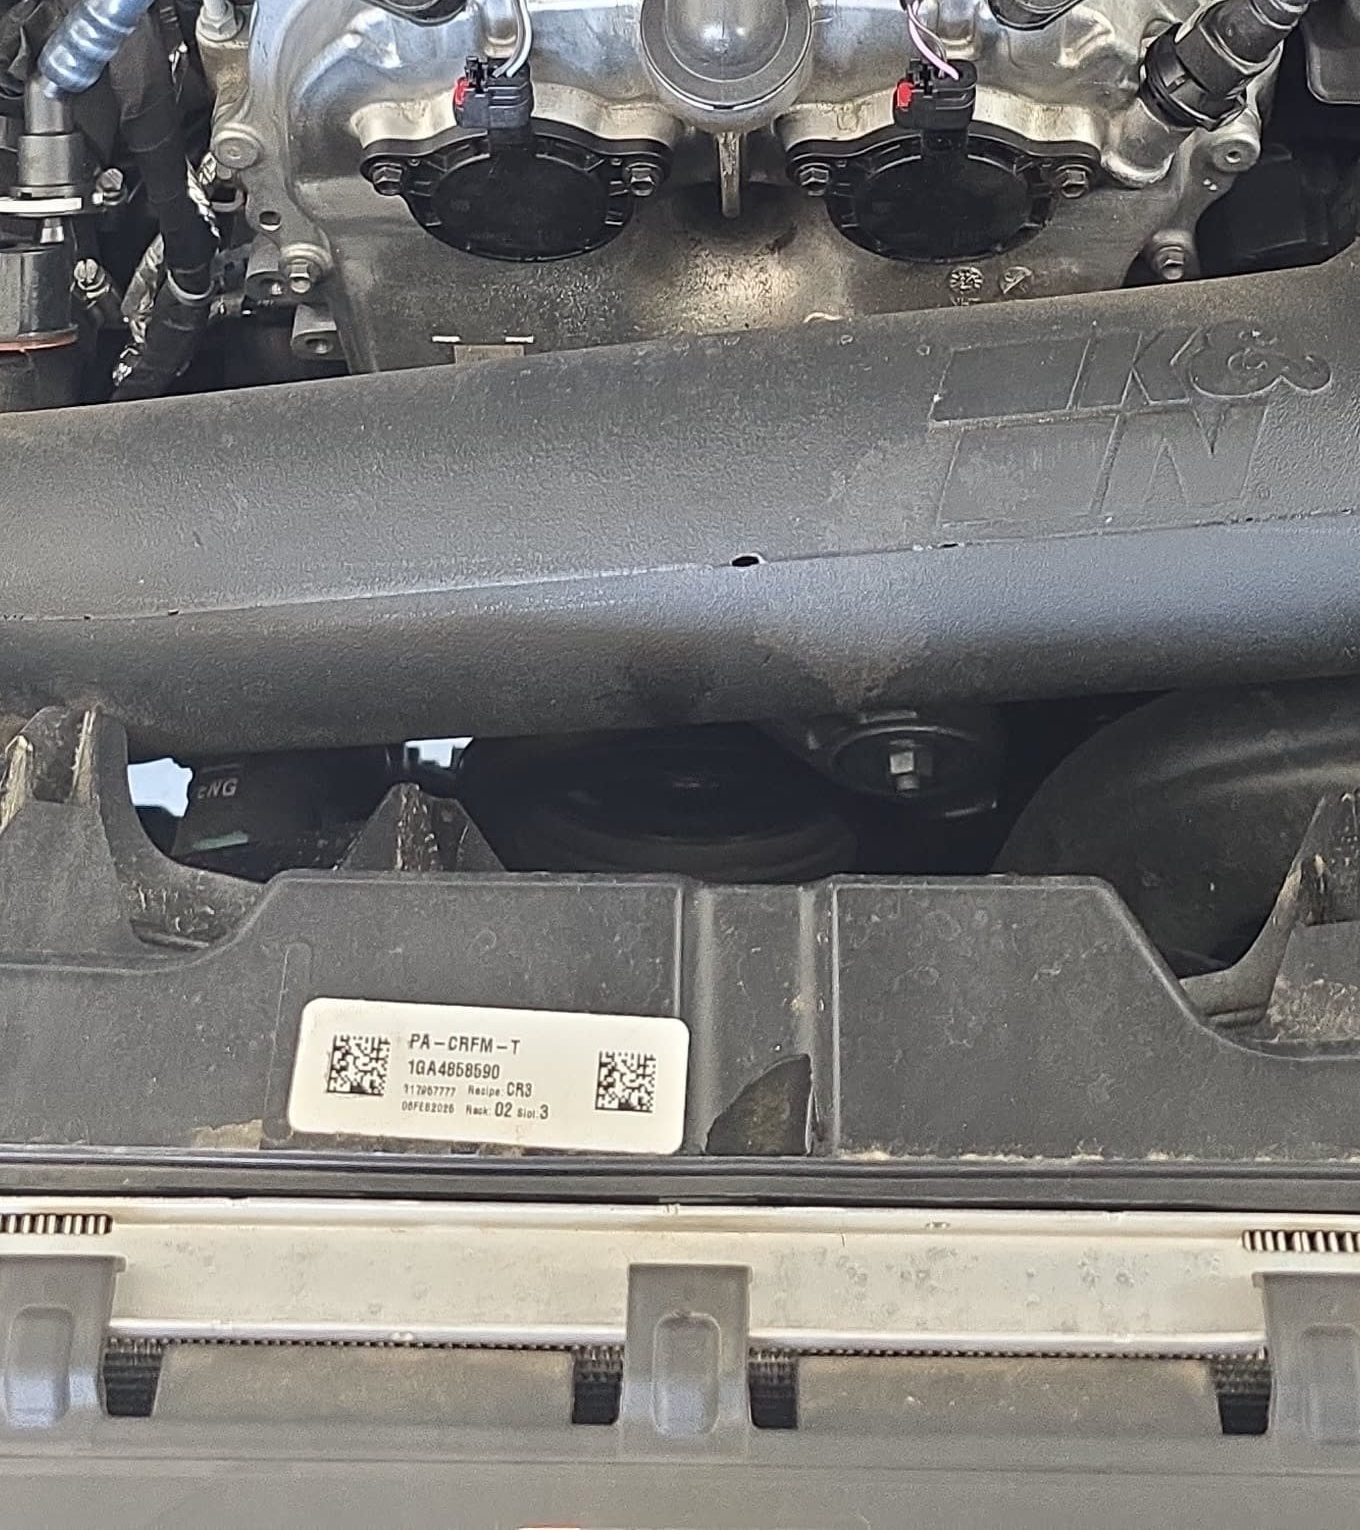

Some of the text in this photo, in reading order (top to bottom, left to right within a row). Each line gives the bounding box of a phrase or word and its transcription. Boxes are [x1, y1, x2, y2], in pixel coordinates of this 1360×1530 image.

[408, 1059, 501, 1080] 1GA4858590
[506, 1081, 533, 1098] CR3
[494, 1101, 513, 1118] 02
